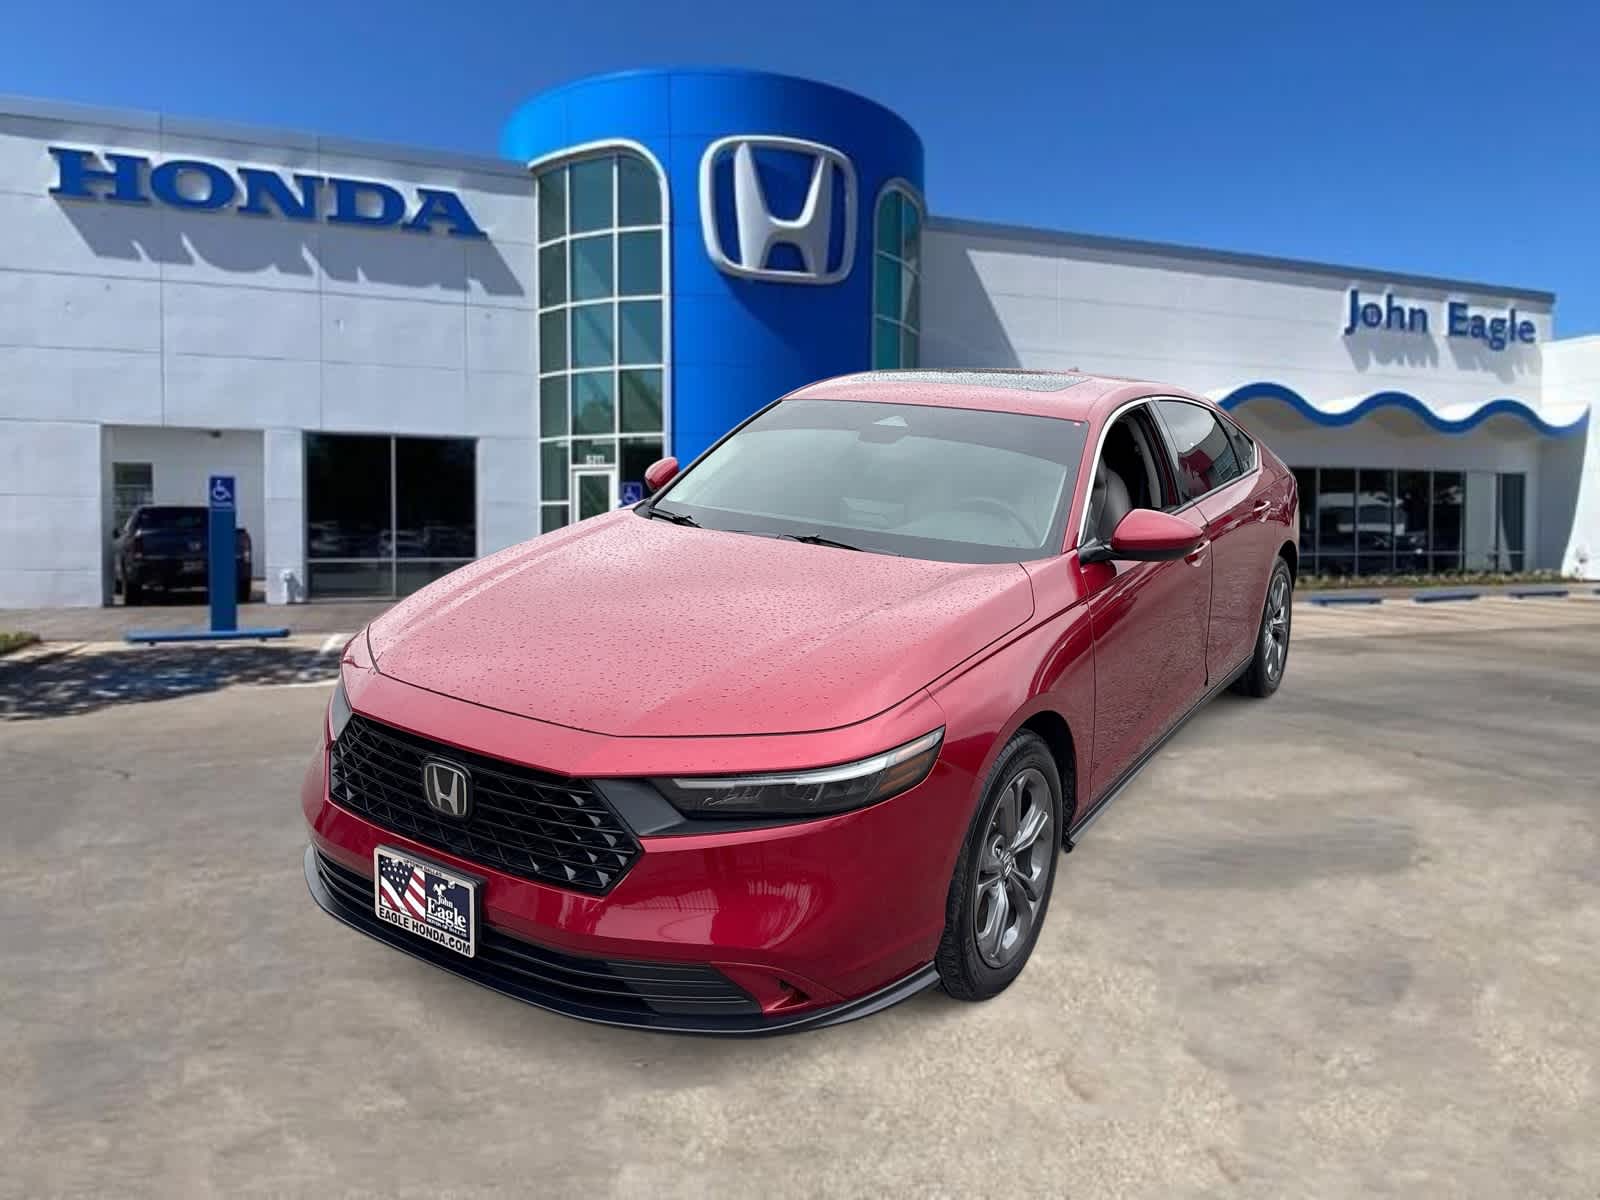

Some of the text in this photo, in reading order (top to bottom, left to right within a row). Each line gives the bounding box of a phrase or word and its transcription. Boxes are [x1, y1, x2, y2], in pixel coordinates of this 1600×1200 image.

[48, 146, 488, 239] HONDA
[1344, 288, 1536, 351] John Eagle
[426, 896, 467, 929] Eagle
[438, 896, 454, 908] John
[379, 907, 410, 929] EAGLE
[412, 920, 471, 956] HONDA.COM
